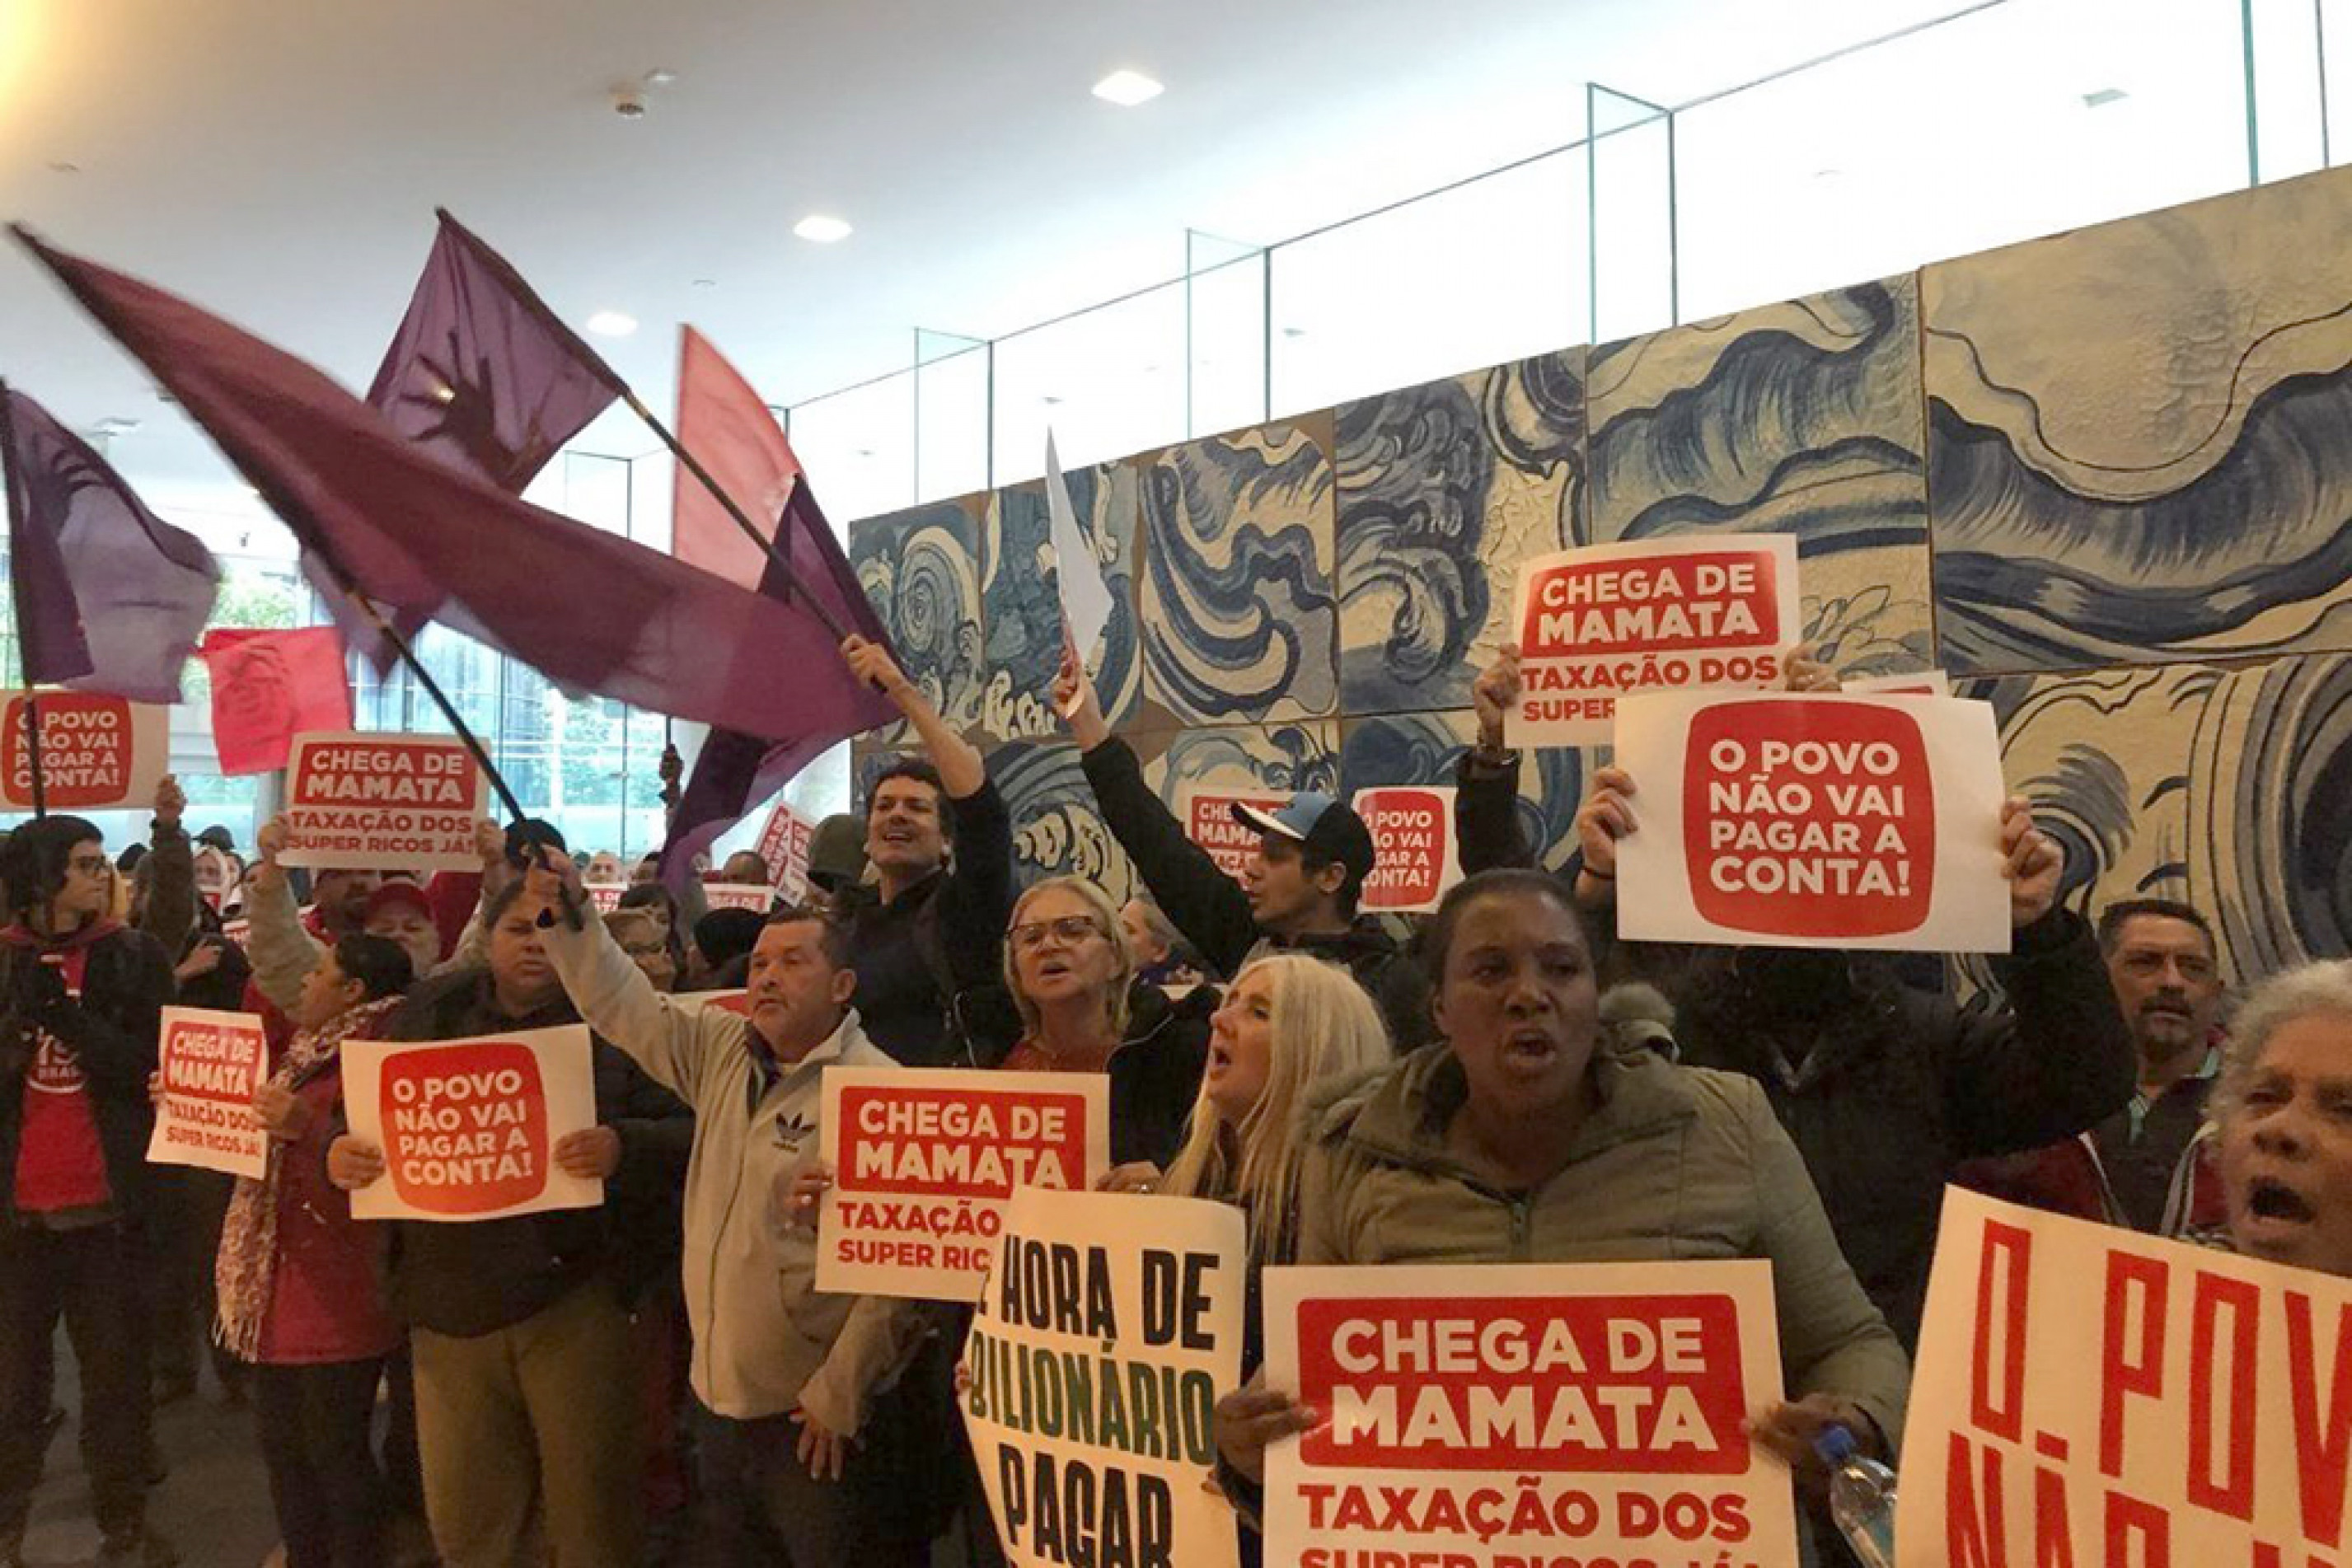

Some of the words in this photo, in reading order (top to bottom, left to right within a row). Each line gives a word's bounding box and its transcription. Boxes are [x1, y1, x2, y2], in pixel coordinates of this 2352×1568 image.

[1542, 568, 1683, 607] CHEGA
[1697, 564, 1755, 595] DE
[1539, 601, 1759, 645] MAMATA
[1520, 653, 1690, 692] TAXAÇÃO
[1700, 656, 1778, 682] DOS
[45, 711, 118, 729] POVO
[78, 733, 118, 749] VAI
[1710, 738, 1744, 773] O
[1762, 741, 1899, 775] POVO
[15, 751, 95, 767] PGAR
[101, 751, 117, 765] A
[312, 750, 414, 772] CHEGA
[424, 752, 464, 775] DE
[305, 774, 464, 803] MAMATA
[1709, 774, 1811, 814] NÃO
[1826, 784, 1905, 817] VAI
[292, 810, 412, 833] TAXAÇÃO
[420, 815, 471, 832] DOS
[1377, 810, 1431, 828] POVO
[288, 835, 361, 852] SUPER
[368, 837, 434, 853] RICOS
[1399, 832, 1431, 848] VAI
[1710, 821, 1859, 854] PAGAR
[1873, 821, 1906, 854] A
[1375, 851, 1410, 867] GAR
[1415, 850, 1429, 866] A
[1365, 868, 1431, 887] ONTA!
[1709, 859, 1910, 896] CONTA!
[173, 1031, 227, 1060] CHEGA
[232, 1037, 259, 1063] DE
[170, 1058, 250, 1095] MAMATA
[392, 1079, 416, 1102] O
[424, 1070, 522, 1102] POVO
[395, 1102, 461, 1131] NÃO
[470, 1099, 526, 1127] VAI
[859, 1101, 998, 1140] CHEGA
[1011, 1107, 1066, 1141] DE
[399, 1131, 496, 1157] PAGAR
[506, 1127, 528, 1150] A
[402, 1152, 533, 1185] CONTA!
[855, 1141, 1069, 1190] MAMATA
[837, 1200, 1000, 1238] TAXAÇÃO
[837, 1239, 939, 1269] SUPER
[944, 1246, 991, 1271] RIC
[1001, 1233, 1117, 1340] HORA
[1141, 1249, 1221, 1351] DE
[1332, 1318, 1586, 1374] CHEGA
[1608, 1318, 1706, 1374] DE
[969, 1329, 1216, 1467] BILIONÁRIO
[1971, 1218, 2032, 1444] O
[2099, 1248, 2352, 1550] POV
[1332, 1384, 1718, 1451] MAMATA
[999, 1443, 1174, 1568] PAGAR
[1298, 1476, 1599, 1545] TAXAÇÃO
[1617, 1491, 1750, 1543] DOS
